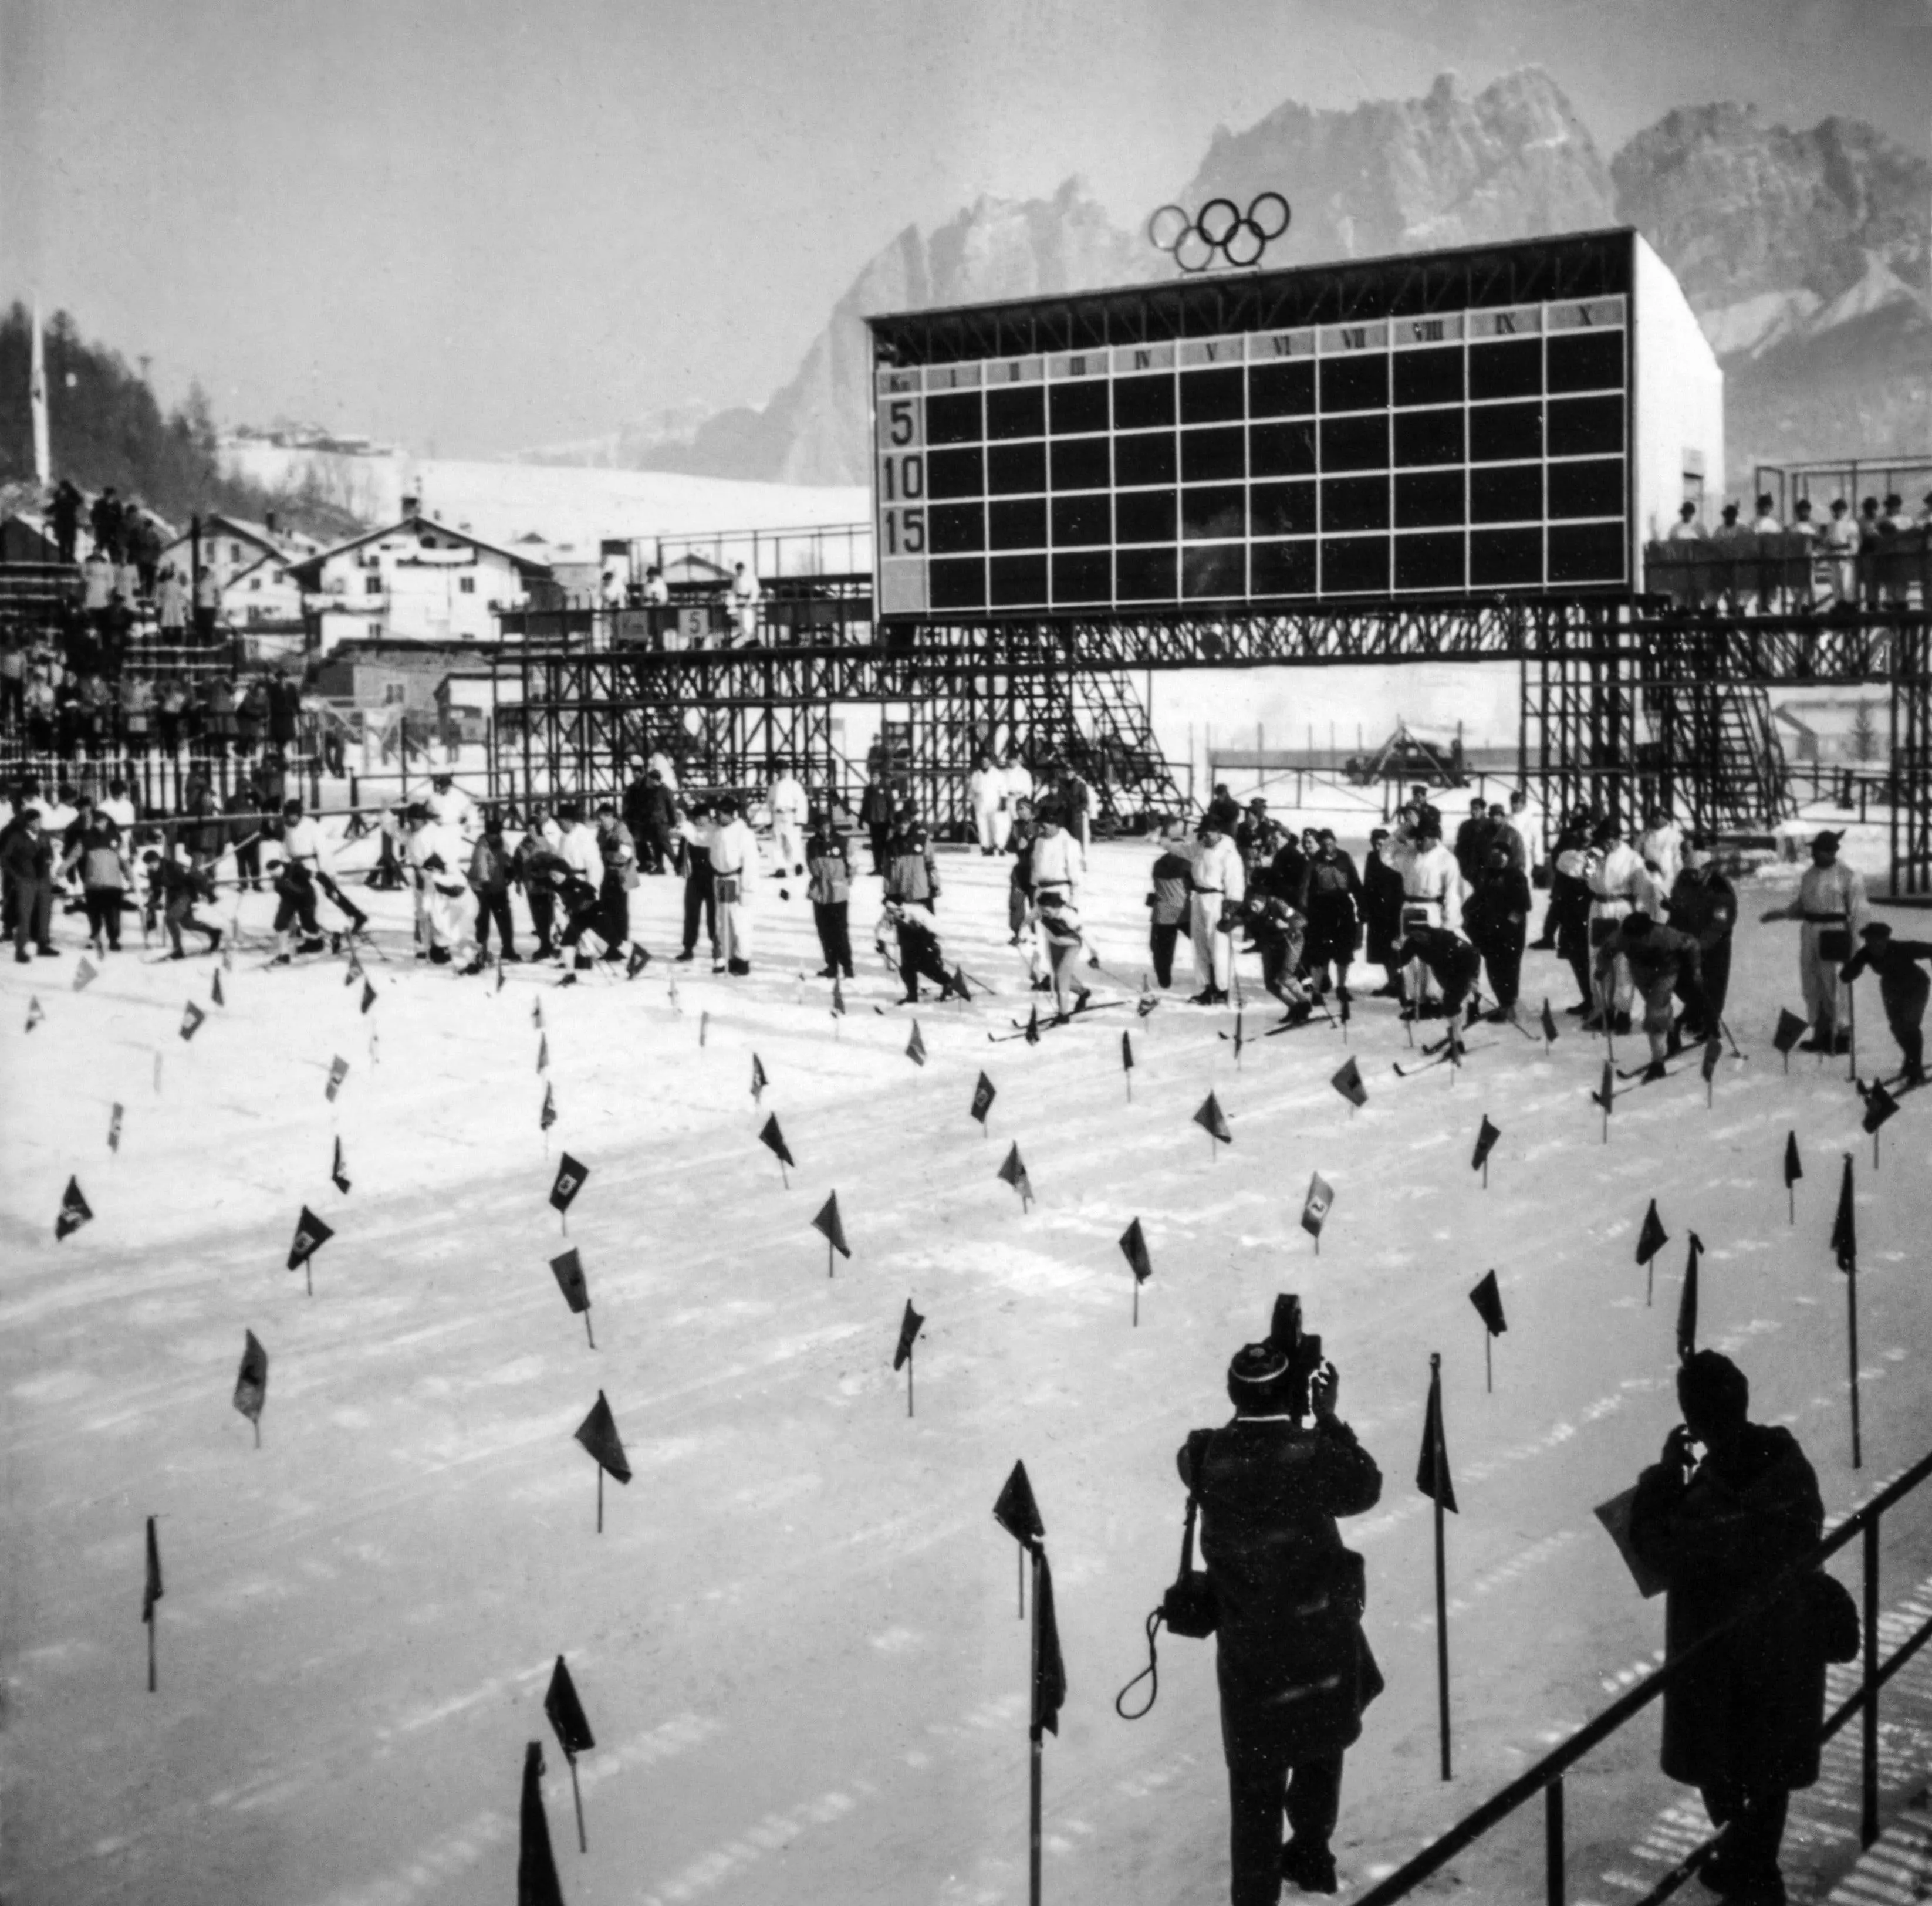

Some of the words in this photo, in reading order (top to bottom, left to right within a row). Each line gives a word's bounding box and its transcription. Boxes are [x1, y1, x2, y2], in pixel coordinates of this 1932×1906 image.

[950, 369, 957, 388] I
[1070, 356, 1086, 376] III
[1135, 350, 1151, 370] IV
[1205, 342, 1217, 362] V
[1273, 335, 1290, 356] VI
[1341, 327, 1366, 349] VII
[1495, 312, 1516, 334] IX
[1577, 303, 1592, 326] X
[891, 401, 913, 446] 5
[884, 455, 923, 499] 10
[886, 509, 924, 554] 15
